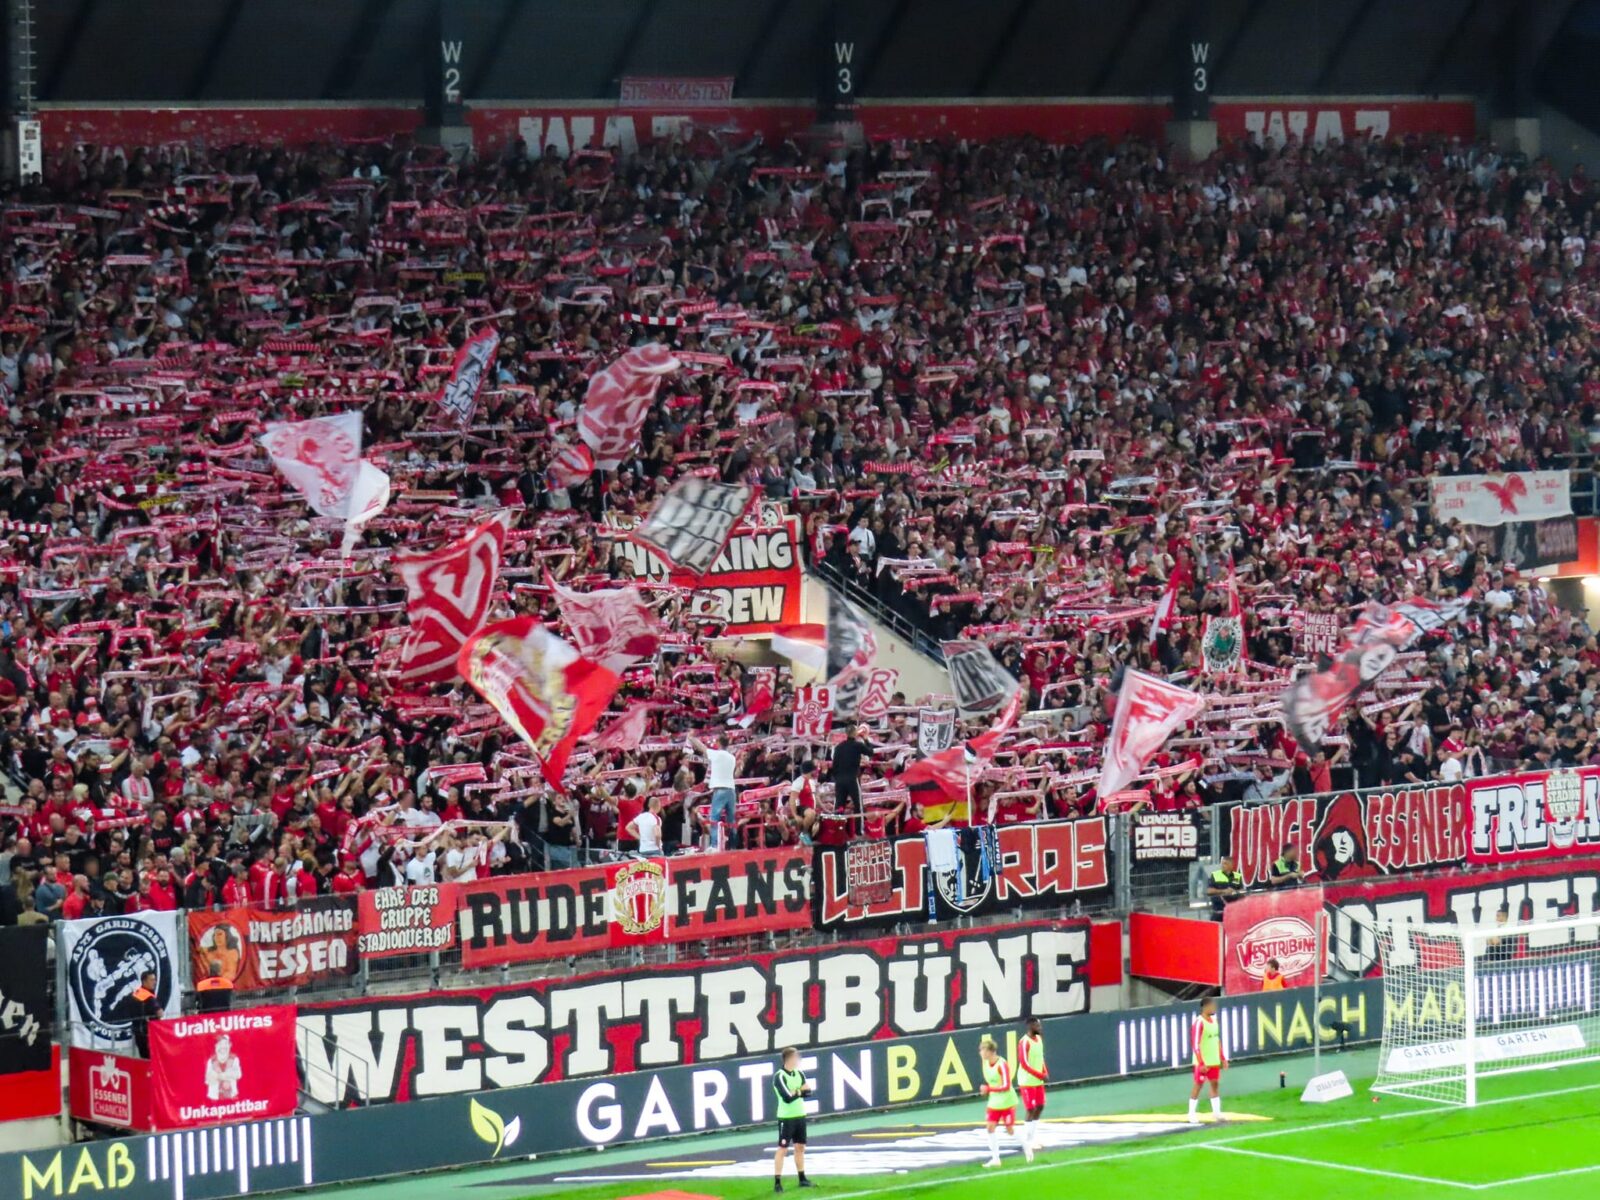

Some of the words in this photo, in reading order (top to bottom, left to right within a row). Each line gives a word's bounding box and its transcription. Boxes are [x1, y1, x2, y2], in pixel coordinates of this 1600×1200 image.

[441, 41, 462, 63] W
[835, 42, 854, 63] W
[1191, 42, 1209, 64] W
[445, 68, 460, 94] 2
[838, 69, 852, 93] 3
[1193, 68, 1207, 92] 3
[691, 586, 785, 624] CREW
[1304, 611, 1338, 626] IMMER
[1304, 624, 1338, 636] WIEDER
[1303, 634, 1338, 653] RWE
[1134, 825, 1198, 848] ACAB
[1230, 798, 1318, 887] JUNGE
[1366, 785, 1467, 869] ESSENER
[374, 888, 405, 910] EHRE
[411, 887, 439, 906] DER
[466, 878, 607, 950] RUDE
[673, 858, 814, 928] FANS
[380, 906, 432, 930] GRUPPE
[358, 922, 453, 953] STADIONVERBOT
[1322, 898, 1425, 972] OT
[258, 938, 348, 981] ESSEN
[175, 1013, 273, 1038] Uralt-Ultras
[296, 930, 1087, 1101] WESTTRIBÜNE
[1258, 994, 1366, 1050] NACH
[94, 1088, 128, 1105] ESSENER
[576, 1049, 874, 1144] GARTEN
[94, 1101, 129, 1118] CHANCEN
[180, 1097, 269, 1121] Unkaputtbar
